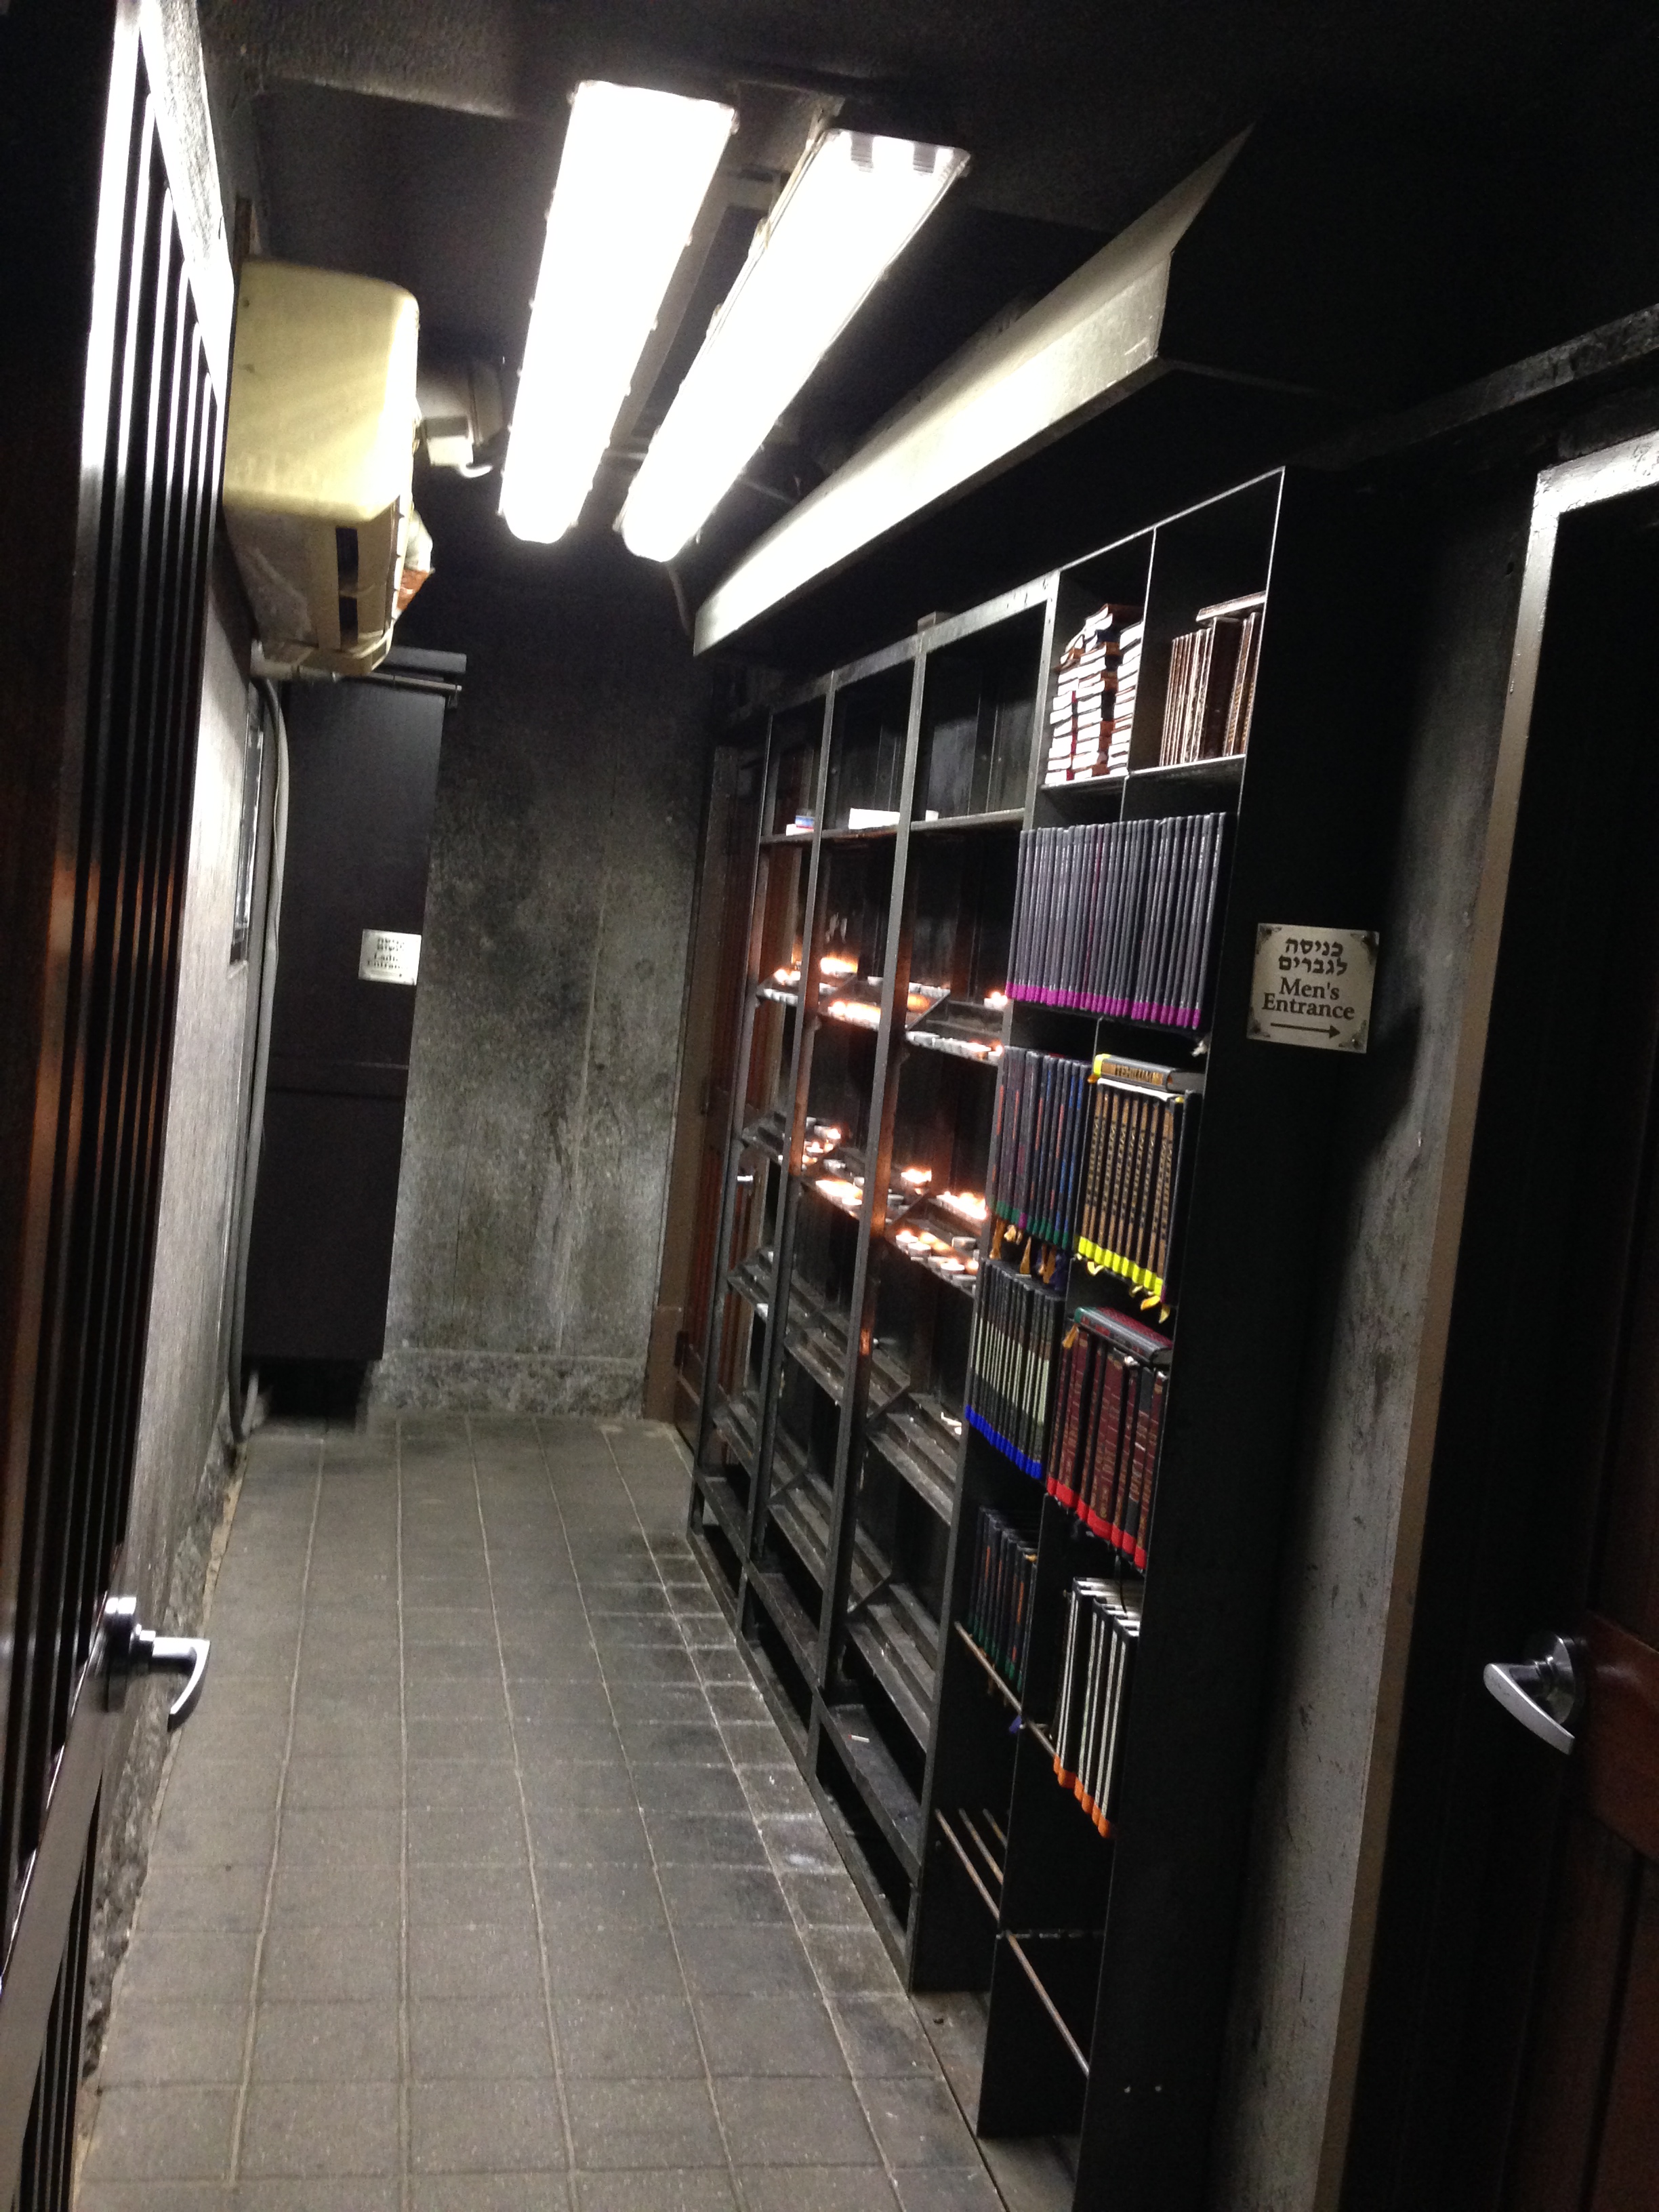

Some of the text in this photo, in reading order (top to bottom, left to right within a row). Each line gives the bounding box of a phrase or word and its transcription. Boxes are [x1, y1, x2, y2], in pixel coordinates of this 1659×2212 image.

[1285, 937, 1344, 958] כניסה
[1278, 954, 1348, 976] לגברים
[1279, 977, 1340, 1000] Men's
[1262, 992, 1355, 1021] Entrance
